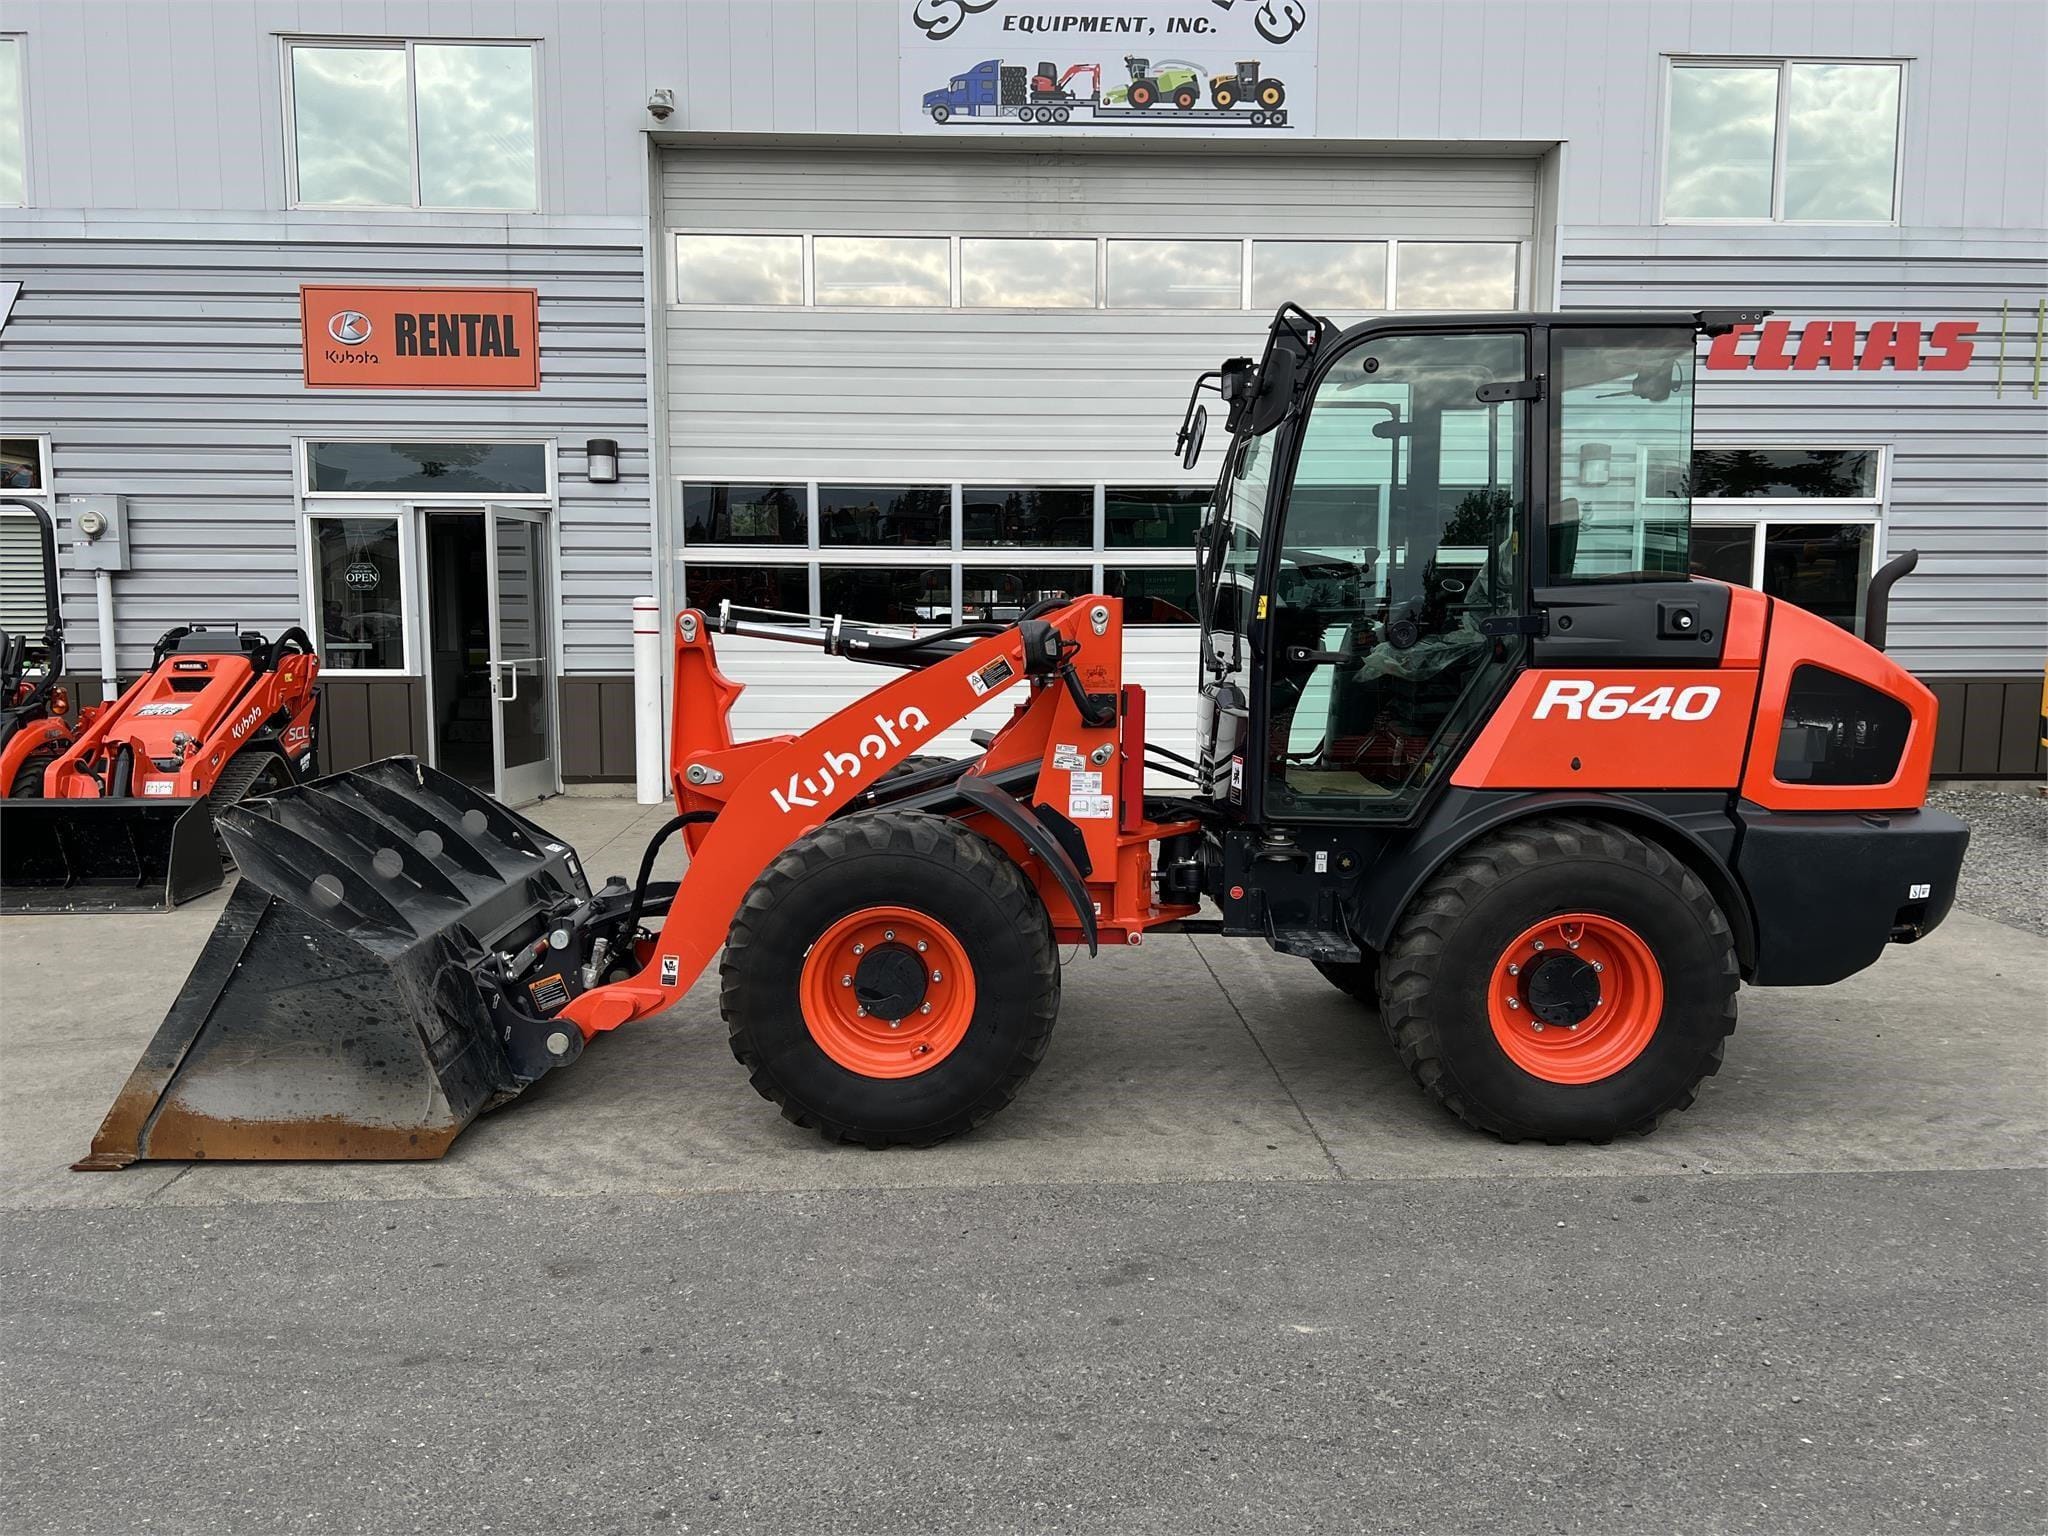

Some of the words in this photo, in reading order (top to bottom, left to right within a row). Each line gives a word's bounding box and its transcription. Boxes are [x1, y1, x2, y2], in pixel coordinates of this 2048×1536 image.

[1002, 16, 1155, 35] EQUIPMENT,
[1166, 17, 1217, 33] INC.
[395, 313, 520, 357] RENTAL
[1706, 321, 1979, 371] CLAAS
[326, 350, 379, 364] Kubota
[346, 573, 377, 582] OPEN
[1532, 680, 1721, 721] R640
[231, 706, 262, 739] Kubota
[770, 706, 930, 814] Kubota
